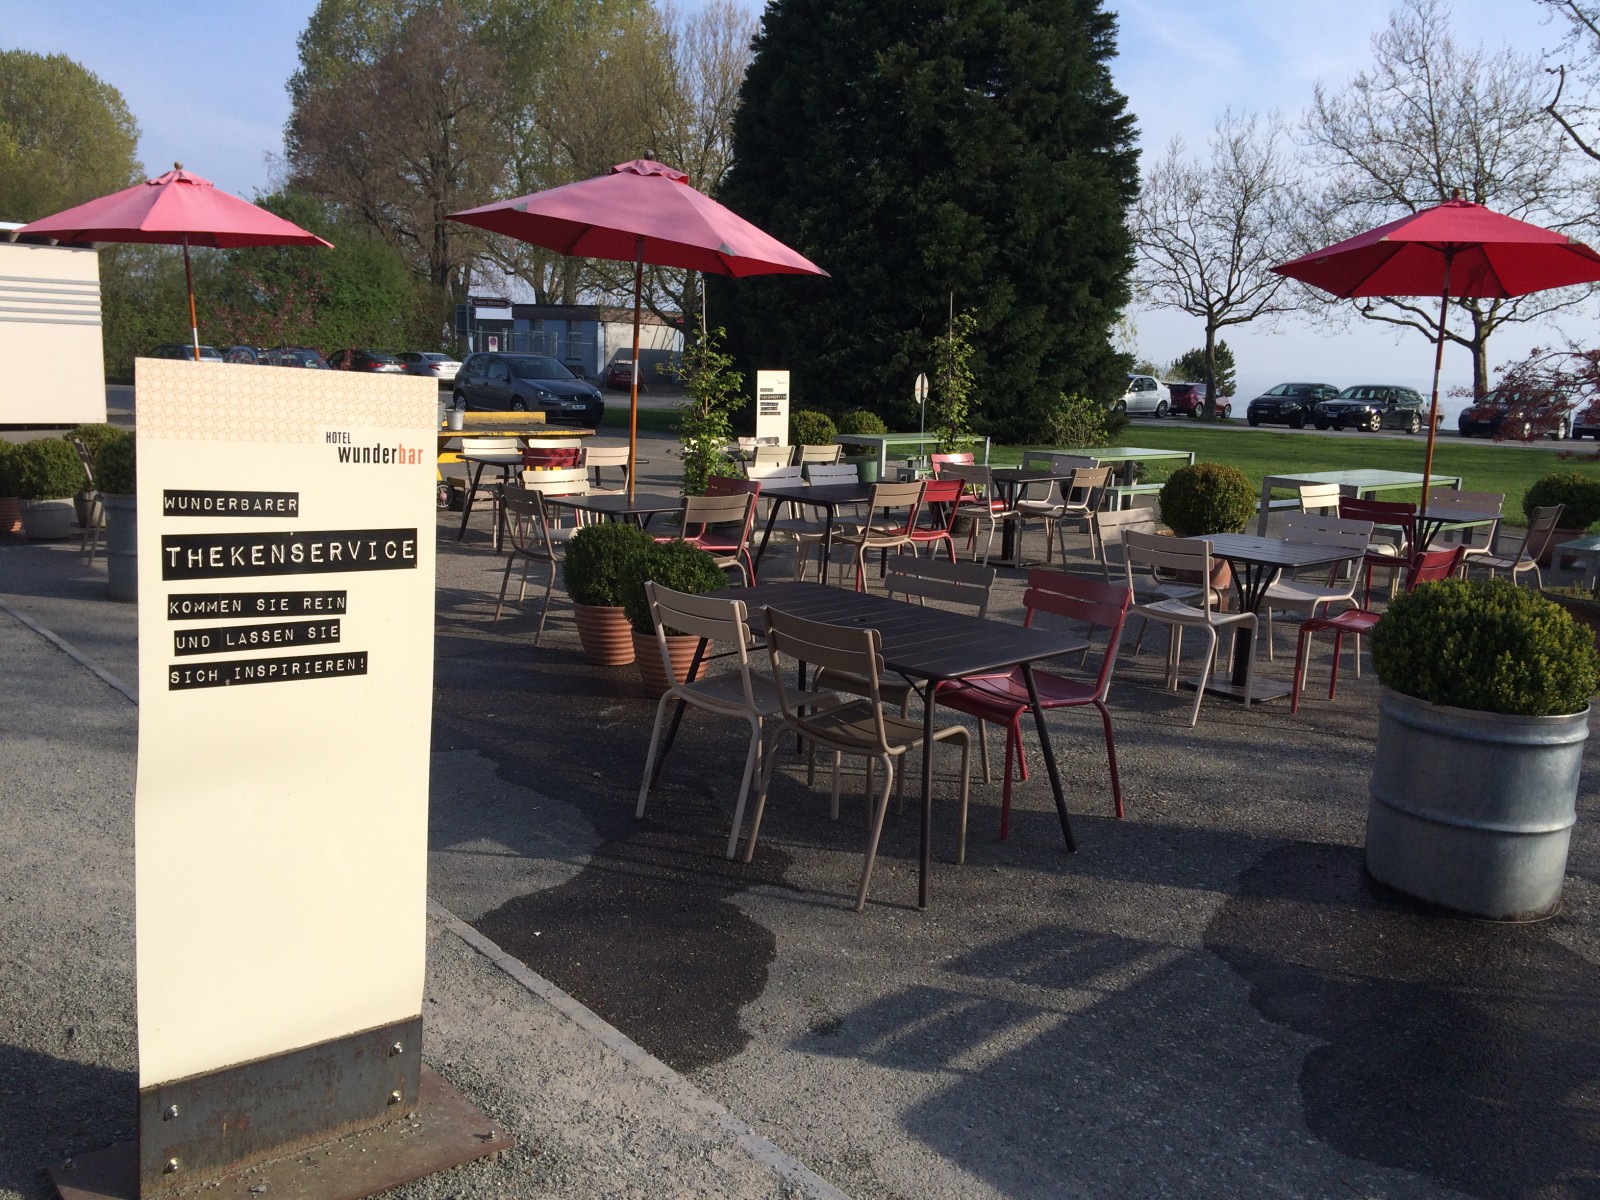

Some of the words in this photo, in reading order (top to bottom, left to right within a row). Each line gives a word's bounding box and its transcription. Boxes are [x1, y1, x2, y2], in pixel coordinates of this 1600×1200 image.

[326, 431, 351, 444] HOTEL
[338, 443, 423, 464] wunderbar
[164, 497, 298, 511] WUNDERBARER
[166, 540, 414, 567] THEKENSERVICE
[170, 600, 242, 614] KOMMEN
[256, 599, 289, 611] SIE
[303, 597, 346, 609] REIN
[176, 635, 211, 650] UND
[226, 629, 294, 646] LASSEN
[308, 625, 339, 639] SIE
[170, 670, 218, 684] SICH
[234, 658, 365, 680] INSPIRIEREN!
